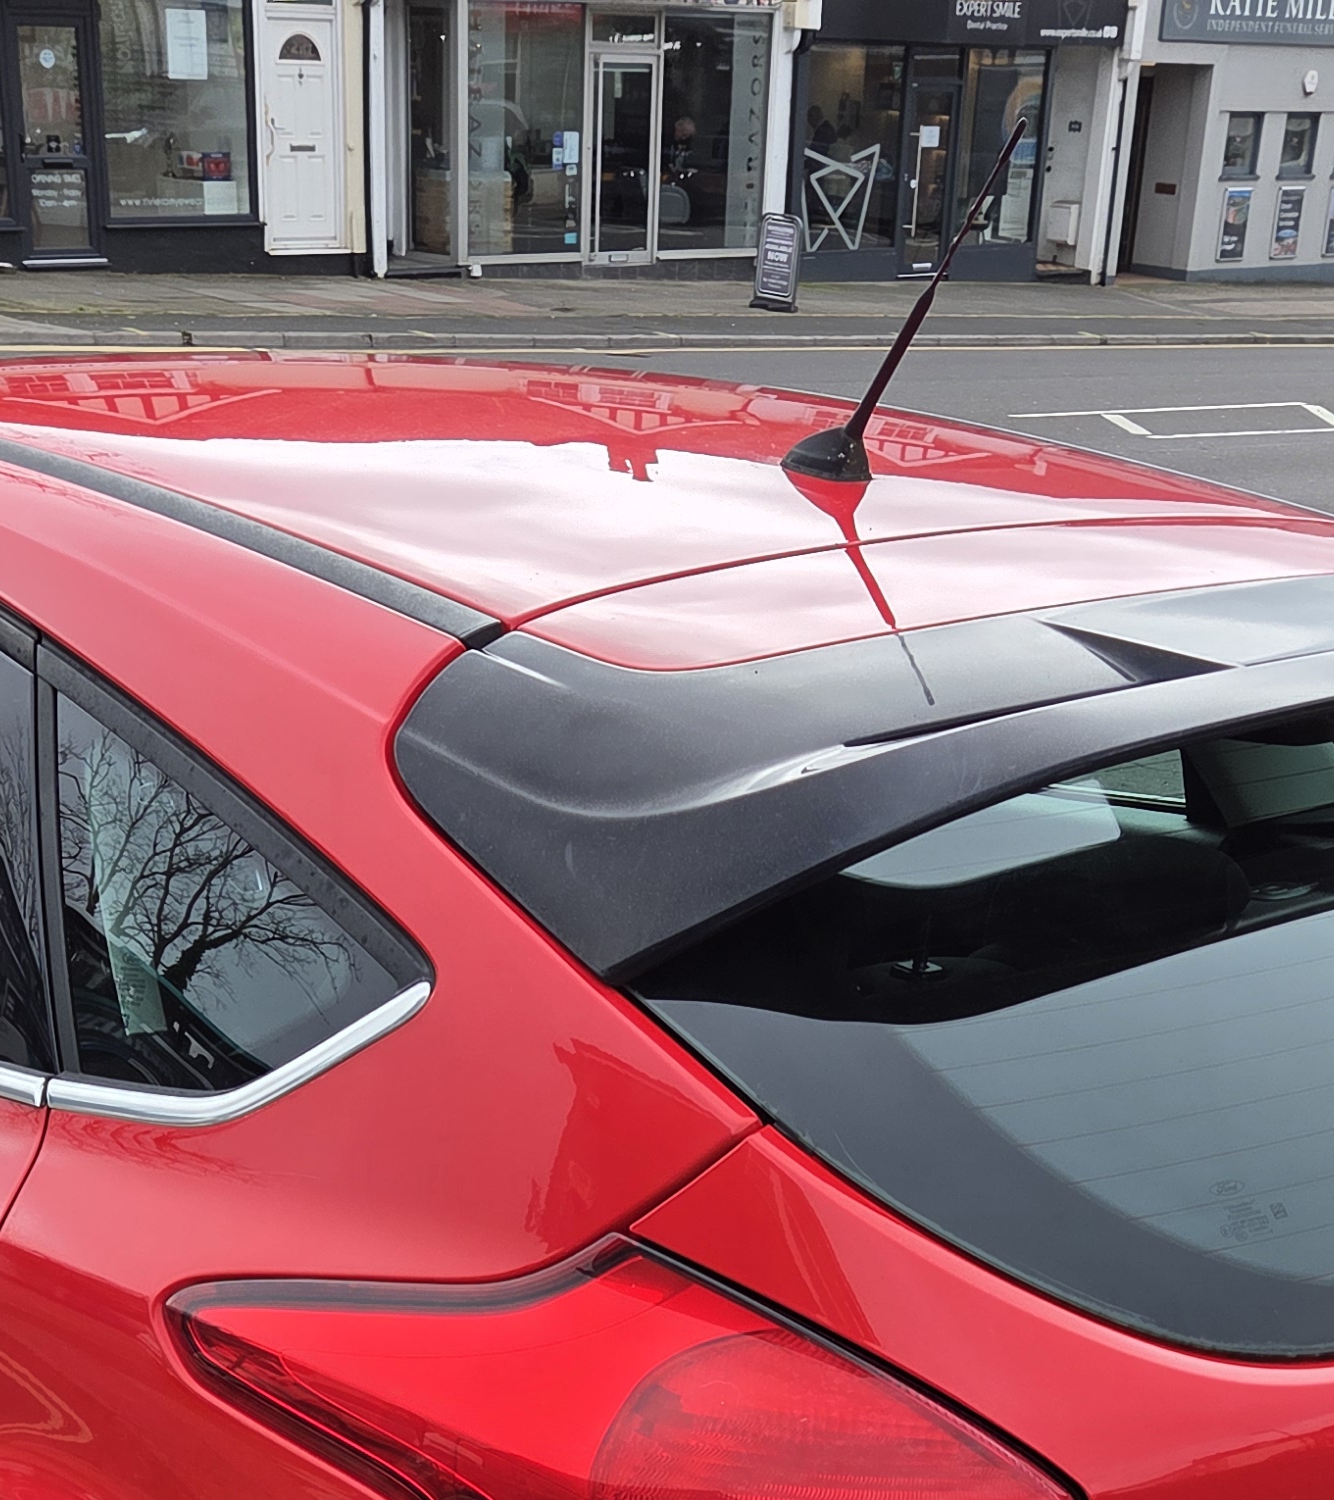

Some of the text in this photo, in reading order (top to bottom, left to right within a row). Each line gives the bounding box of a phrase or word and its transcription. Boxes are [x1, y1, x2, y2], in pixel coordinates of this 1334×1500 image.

[956, 0, 1021, 18] EXPERT SMILE
[1209, 0, 1278, 17] KATIE
[1207, 19, 1271, 33] INDEPENDENT
[1274, 22, 1313, 35] FUNERAL
[767, 251, 788, 262] NOW
